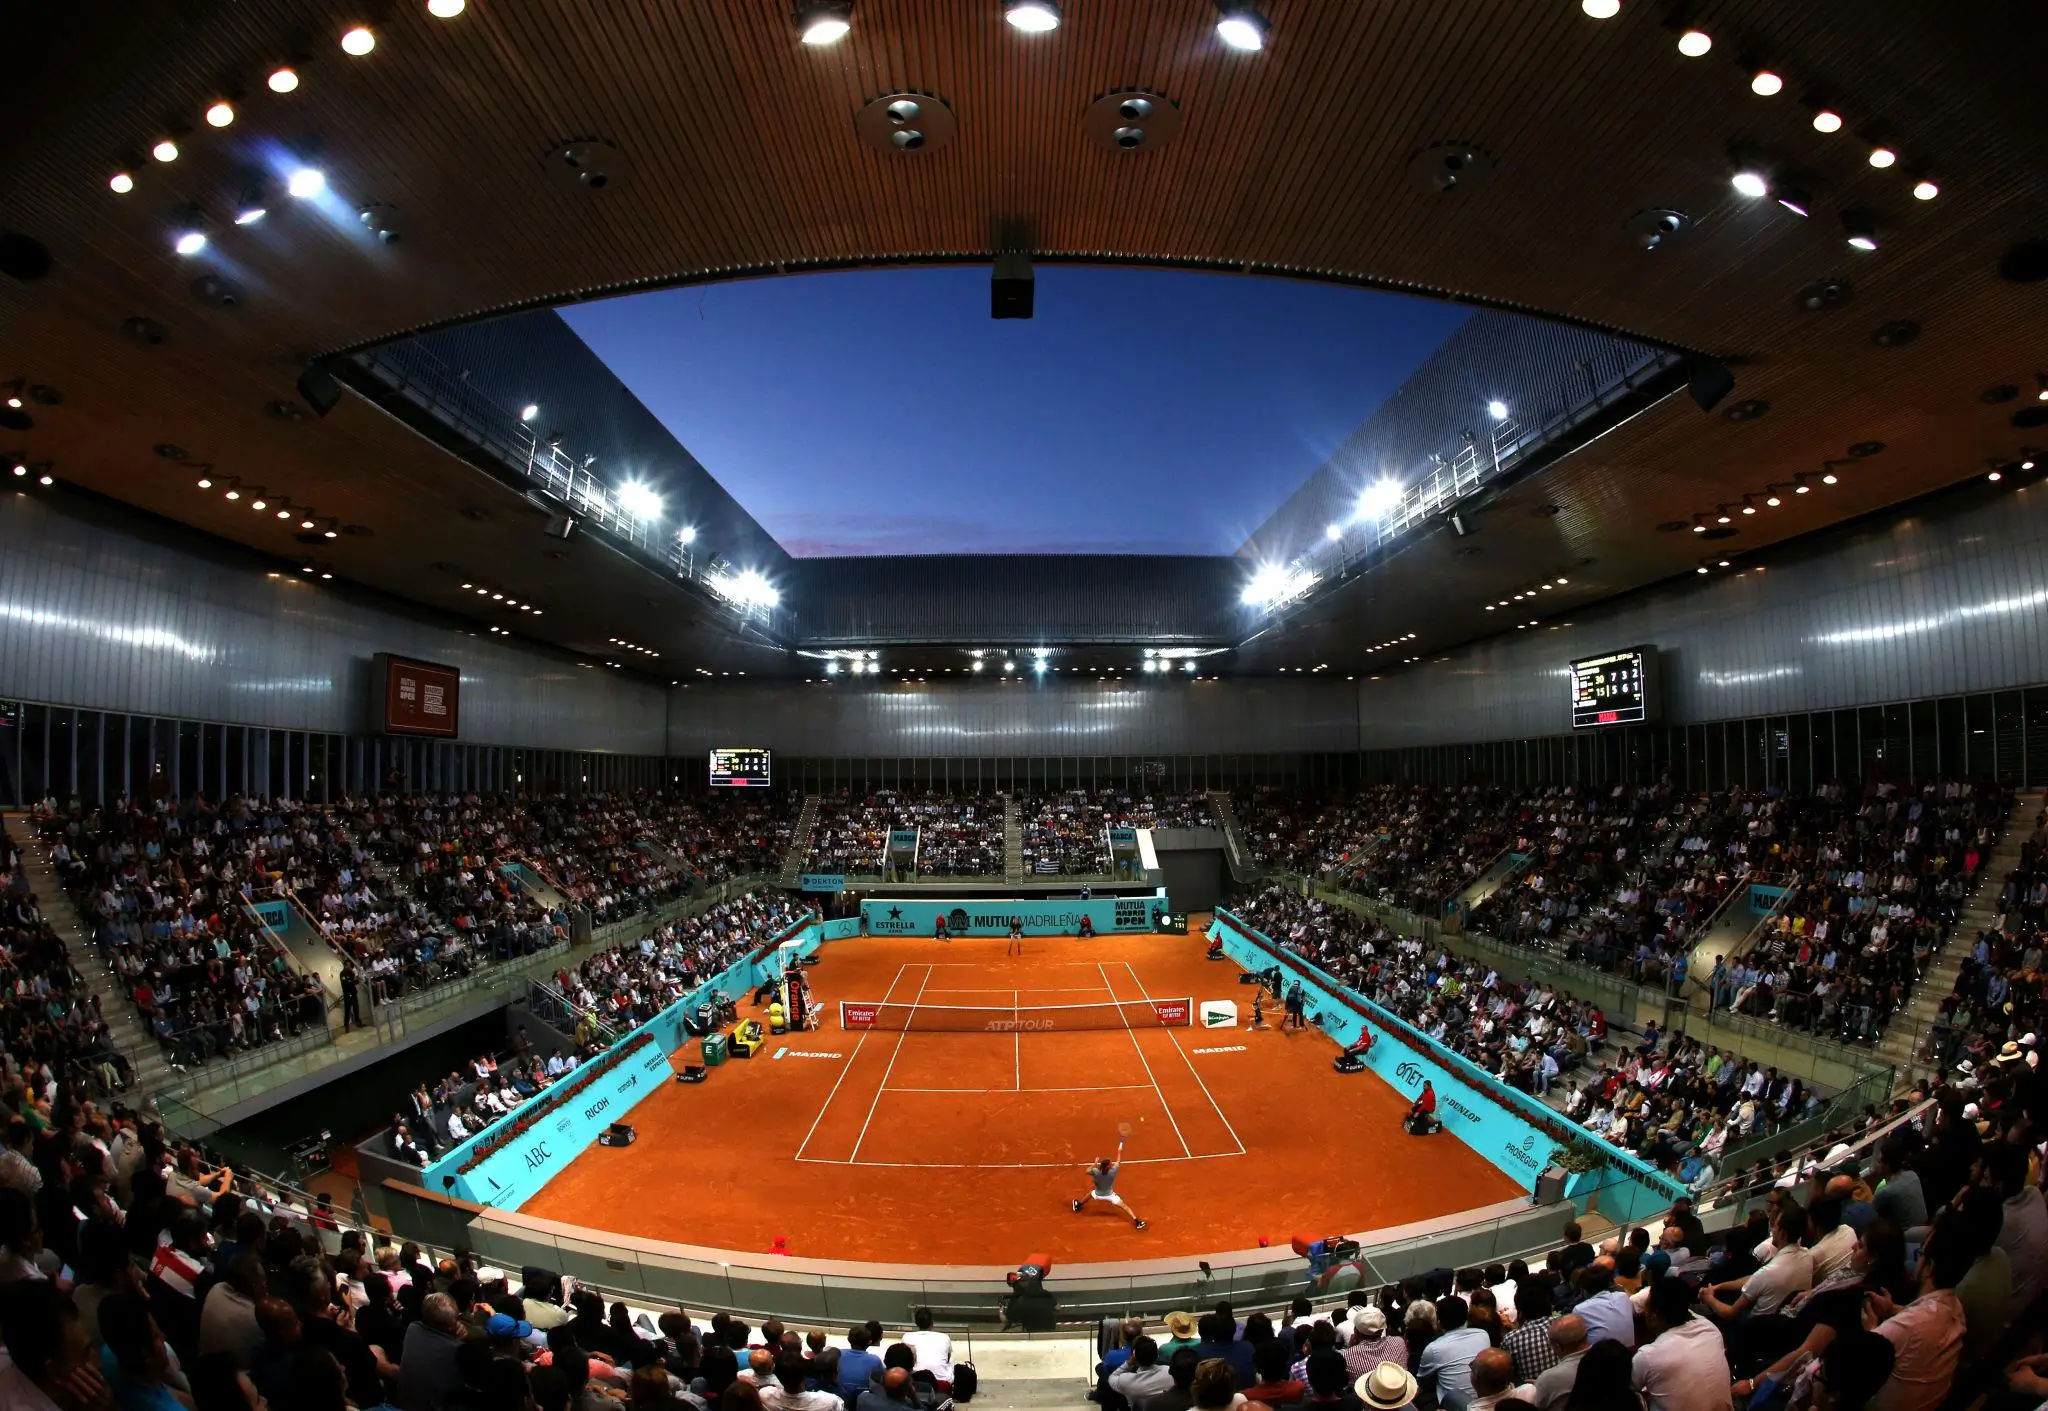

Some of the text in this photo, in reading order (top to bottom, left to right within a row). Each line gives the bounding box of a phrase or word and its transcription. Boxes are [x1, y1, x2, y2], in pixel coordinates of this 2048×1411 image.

[1595, 675, 1605, 684] 30
[1611, 673, 1616, 682] 7
[1622, 670, 1628, 680] 3
[1632, 668, 1638, 678] 2
[1596, 682, 1638, 696] 15 5 6 1
[1116, 901, 1146, 910] MUTUA
[974, 916, 1020, 928] MUTU
[1116, 917, 1146, 926] OPEN
[790, 980, 800, 1021] Orange
[984, 1020, 1054, 1030] ATP TOUR
[1192, 1046, 1246, 1054] MADRID
[644, 1052, 663, 1069] AMERICAN
[650, 1057, 666, 1072] EXPRESS
[585, 1097, 610, 1120] RICOH
[1448, 1098, 1482, 1122] DUNLOP
[524, 1140, 552, 1172] ABC
[1504, 1142, 1538, 1170] PROSEGUR
